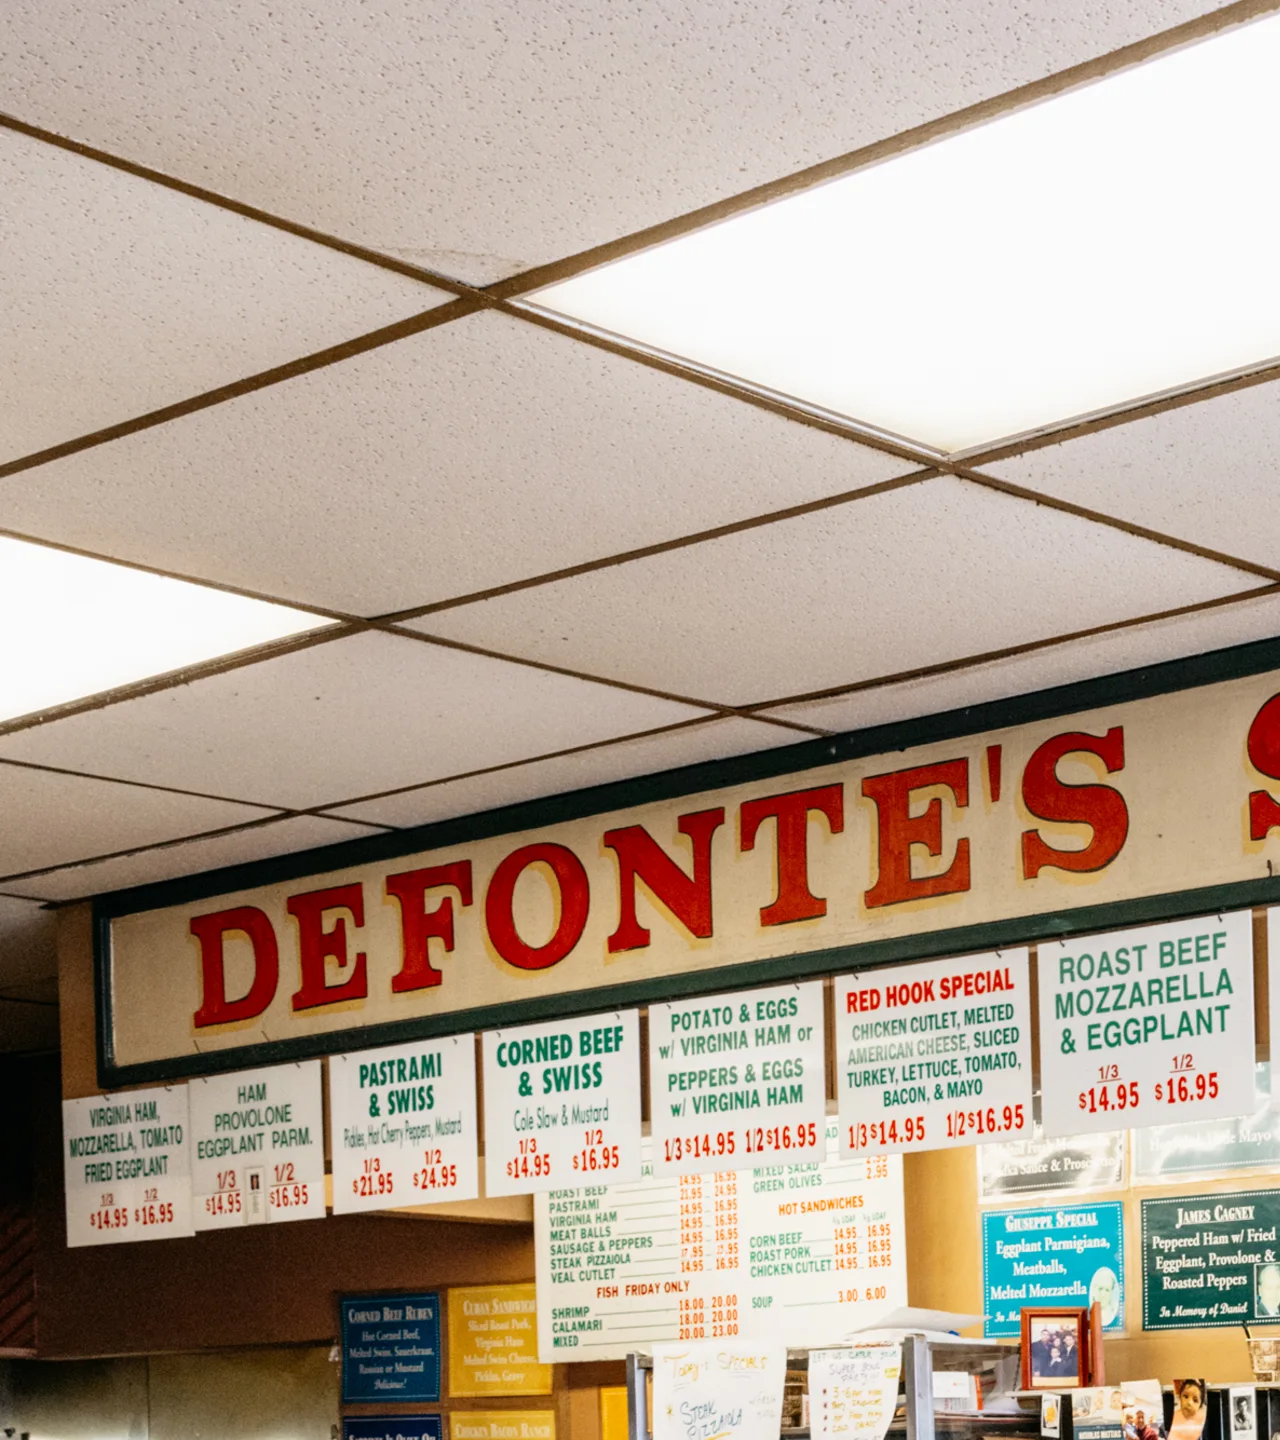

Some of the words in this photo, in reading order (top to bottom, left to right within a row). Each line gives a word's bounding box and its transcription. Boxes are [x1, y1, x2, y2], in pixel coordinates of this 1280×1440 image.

[190, 727, 1127, 1027] DEFONTE'S
[1060, 944, 1147, 984] ROAST
[1159, 932, 1227, 968] BEEF
[847, 989, 881, 1013] RED
[886, 980, 935, 1008] HOOK
[940, 968, 1014, 1000] SPECIAL
[1055, 968, 1234, 1021] MOZZARELLA
[670, 1010, 734, 1032] POTATO
[739, 1005, 752, 1024] &
[757, 997, 797, 1020] EGGS
[852, 1018, 907, 1041] CHICKEN
[910, 1011, 960, 1033] CUTLET,
[964, 1003, 1014, 1026] MELTED
[1061, 1028, 1076, 1054] &
[1088, 1004, 1232, 1050] EGGPLANT
[497, 1032, 572, 1068] CORNED
[580, 1026, 623, 1056] BEEF
[359, 1052, 441, 1088] PASTRAMI
[518, 1071, 532, 1097] &
[543, 1062, 602, 1094] SWISS
[238, 1083, 266, 1104] HAM
[369, 1095, 381, 1117] &
[385, 1087, 434, 1114] SWISS
[1079, 1082, 1139, 1113] $14.95
[1155, 1072, 1218, 1104] $16.95
[89, 1105, 132, 1128] VIRGINIA
[135, 1101, 160, 1122] HAM,
[215, 1104, 292, 1132] PROVOLONE
[344, 1126, 366, 1148] Pickles,
[369, 1123, 383, 1143] Hot
[381, 1123, 404, 1149] Cherry
[405, 1118, 433, 1144] Peppers,
[435, 1113, 461, 1136] Mustard
[514, 1108, 534, 1132] Cole
[537, 1106, 558, 1129] Slaw
[561, 1104, 568, 1126] &
[572, 1098, 608, 1124] Mustard
[69, 1132, 136, 1159] MOZZARELLA,
[140, 1125, 183, 1148] TOMATO
[198, 1134, 266, 1160] EGGPLANT
[272, 1127, 312, 1148] PARM.
[85, 1162, 112, 1184] FRIED
[115, 1155, 168, 1180] EGGPLANT
[778, 1202, 797, 1216] HOT
[800, 1195, 864, 1213] SANDWICHES
[597, 1286, 621, 1298] FISH
[626, 1283, 660, 1296] FRIDAY
[665, 1280, 690, 1295] ONLY
[552, 1306, 590, 1320] SHRIMP
[553, 1320, 602, 1333] CALAMARI
